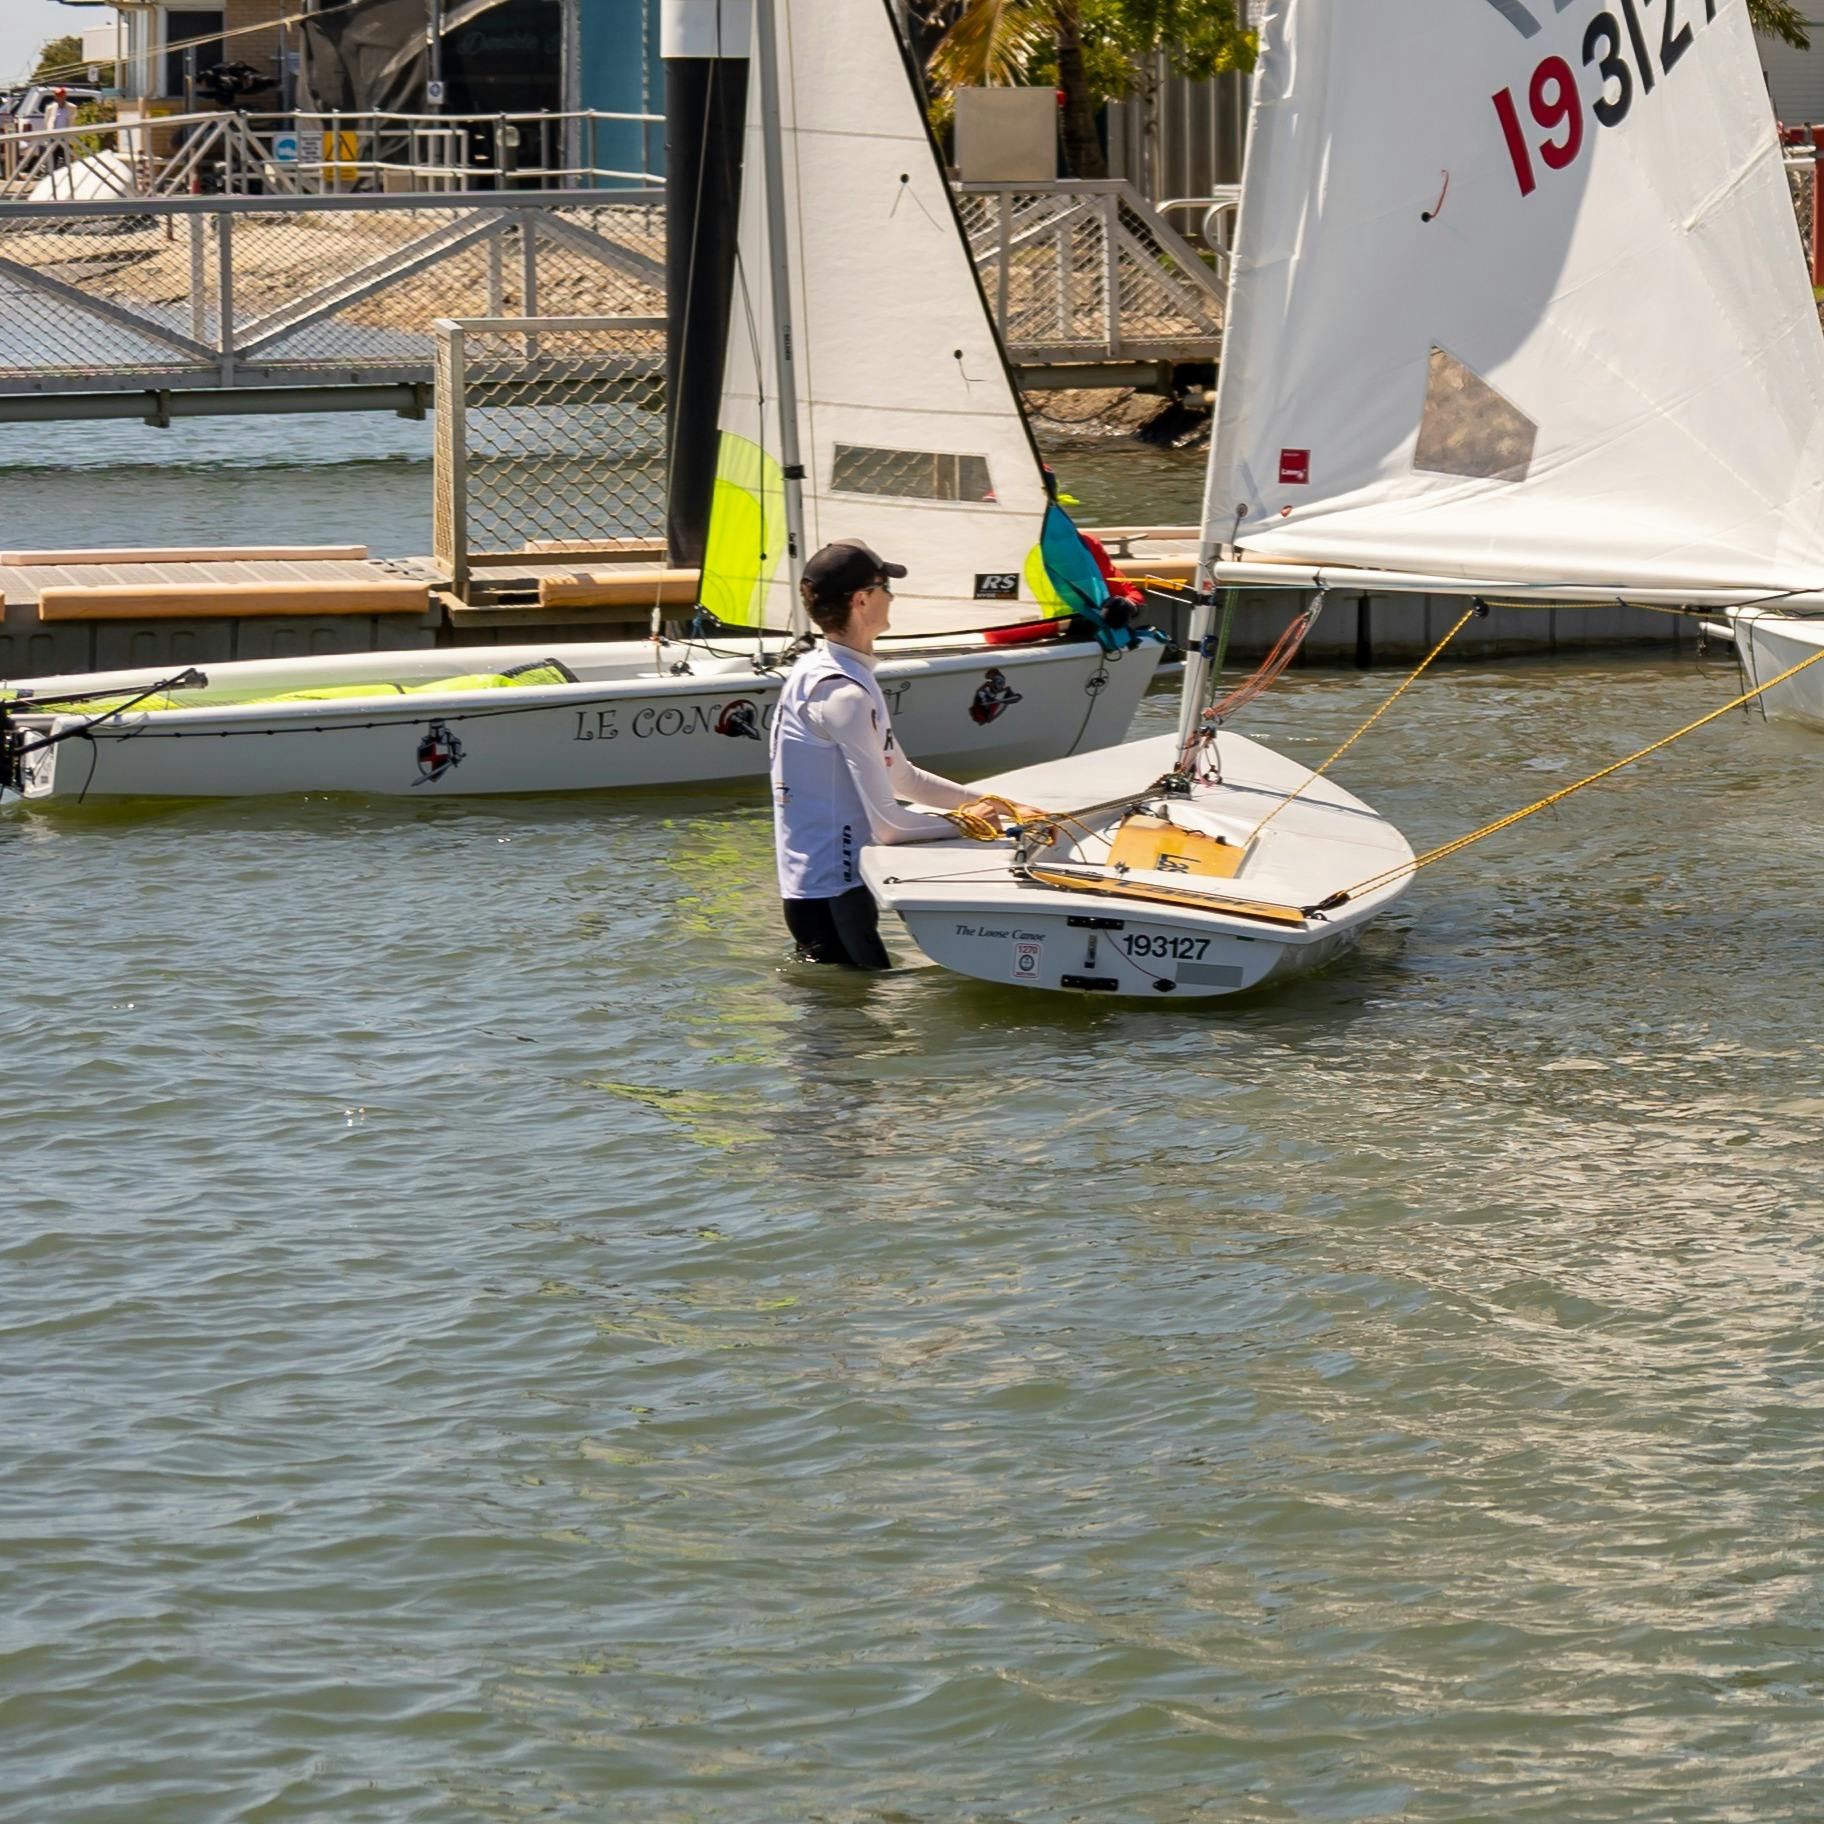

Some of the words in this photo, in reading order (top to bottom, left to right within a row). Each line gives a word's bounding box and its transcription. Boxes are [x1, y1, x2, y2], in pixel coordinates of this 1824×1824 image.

[981, 575, 1016, 589] RS
[573, 709, 620, 742] LE
[955, 925, 981, 937] The
[982, 926, 1009, 939] Loose
[1012, 928, 1047, 941] Canoe
[1123, 934, 1212, 961] 193127
